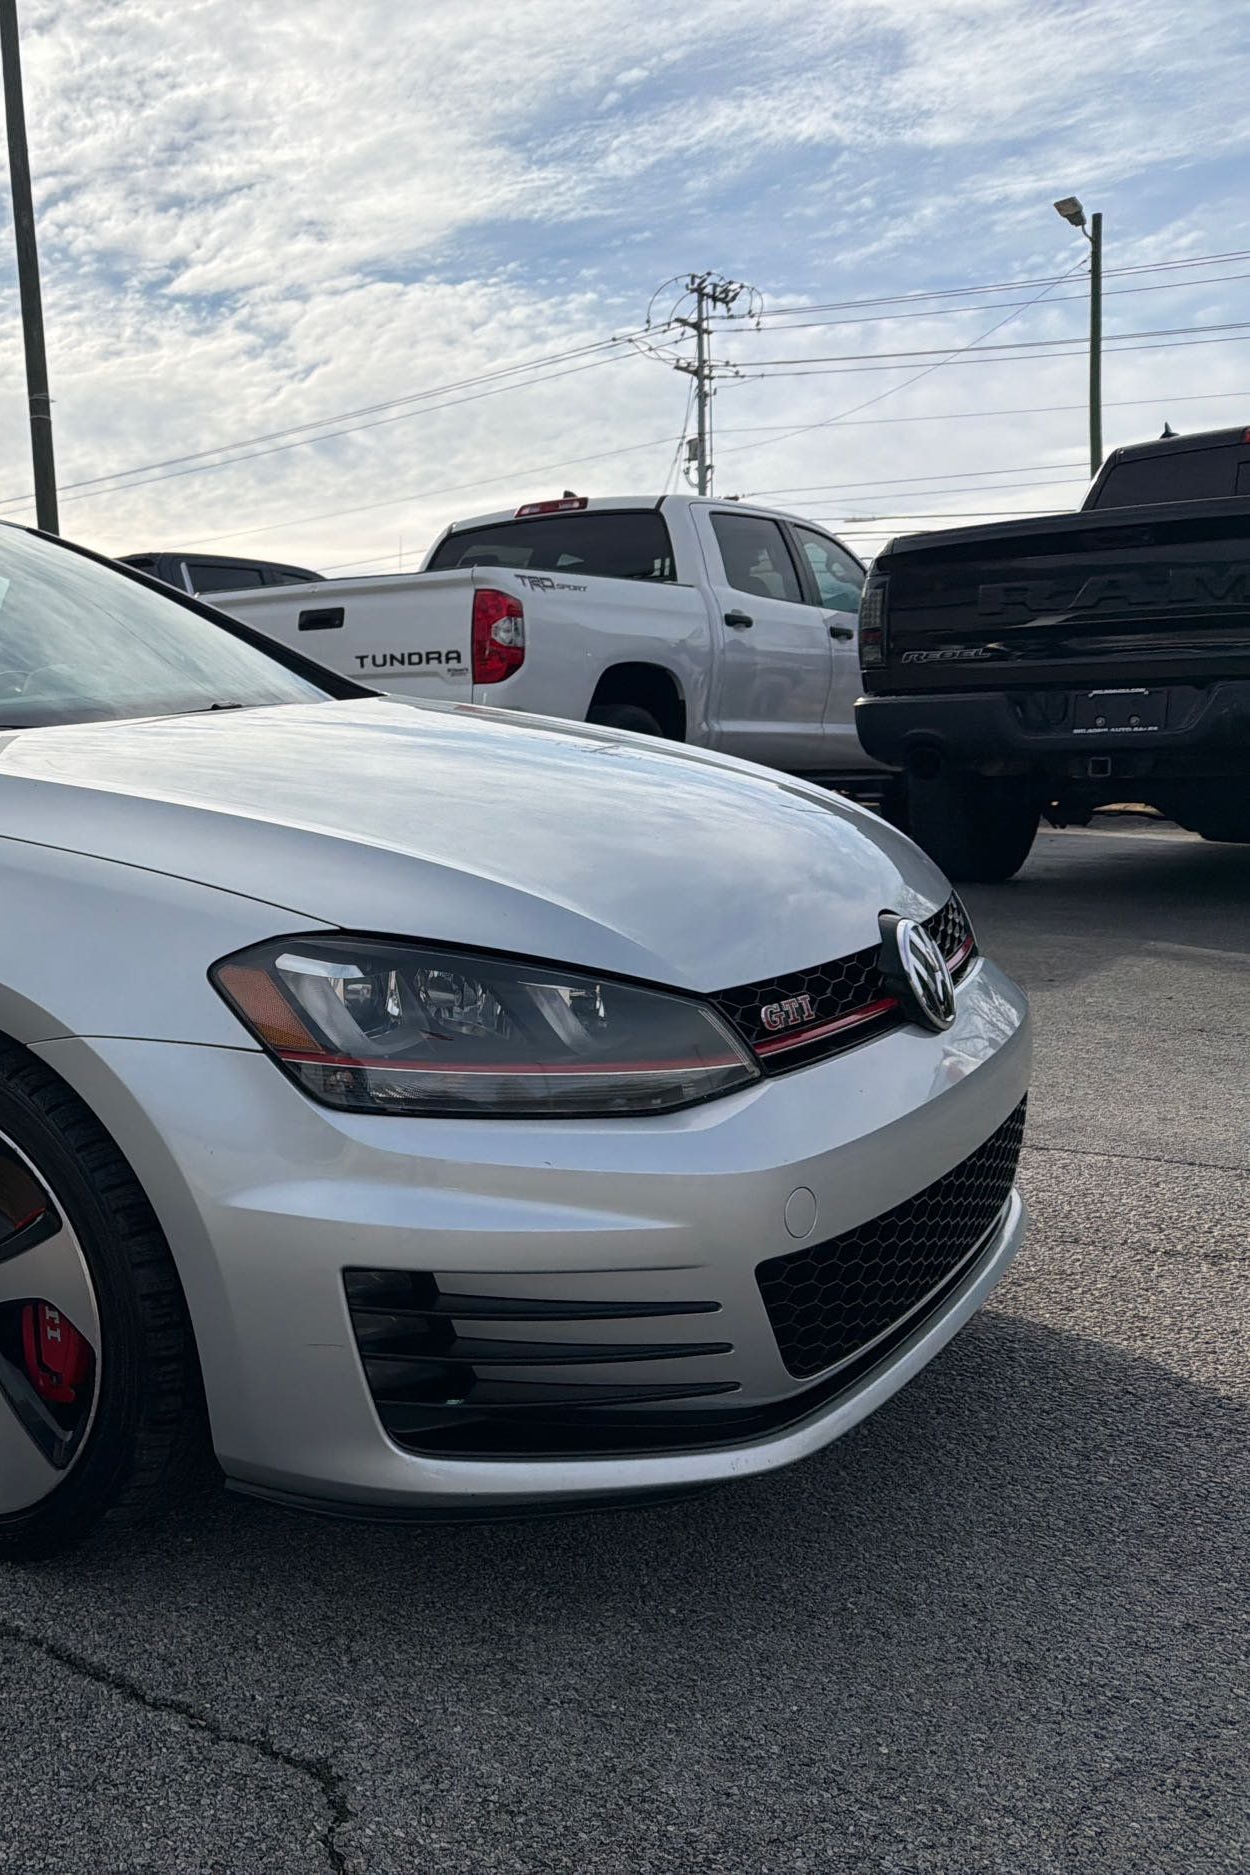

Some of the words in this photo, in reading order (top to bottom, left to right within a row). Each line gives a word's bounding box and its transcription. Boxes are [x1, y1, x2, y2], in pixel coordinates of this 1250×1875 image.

[514, 574, 556, 592] TRD
[355, 650, 462, 669] TUNDRA
[901, 648, 991, 663] REBEL
[761, 994, 816, 1031] GTI
[45, 1306, 62, 1343] TI
